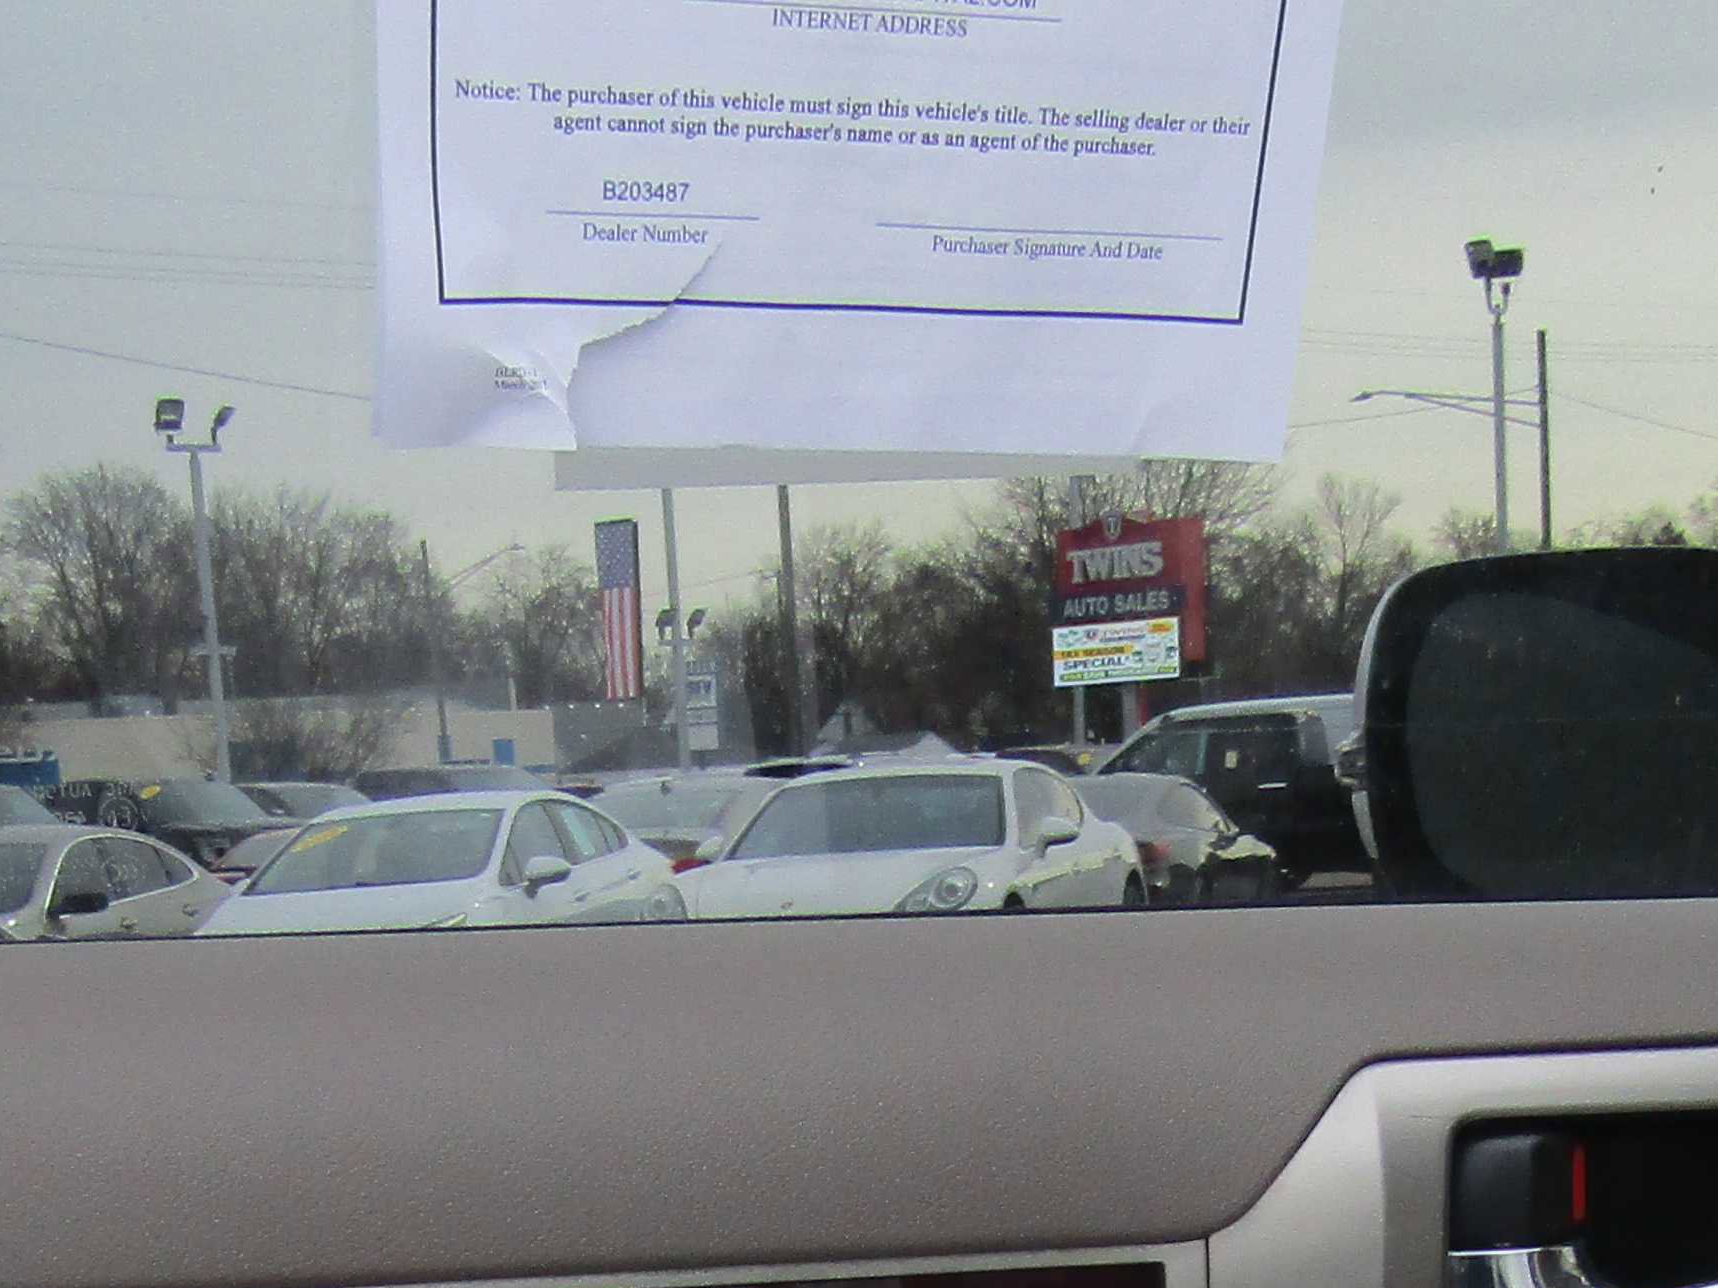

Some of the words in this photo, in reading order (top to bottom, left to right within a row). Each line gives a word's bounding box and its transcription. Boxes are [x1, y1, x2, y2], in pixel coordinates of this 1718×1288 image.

[773, 8, 872, 31] INTERNET
[877, 16, 968, 37] ADDRESS
[455, 79, 520, 101] Notice:
[528, 83, 561, 102] The
[567, 86, 653, 107] purchaser
[659, 89, 680, 106] of
[683, 90, 715, 109] this
[722, 92, 784, 112] vehicle
[790, 98, 832, 115] must
[837, 97, 872, 120] sign
[878, 99, 909, 118] this
[915, 102, 989, 122] vehicle's
[995, 105, 1032, 126] title.
[1039, 107, 1070, 126] The
[1075, 109, 1129, 133] selling
[1135, 111, 1185, 132] dealer
[1190, 119, 1207, 133] or
[1213, 116, 1251, 136] their
[553, 116, 601, 134] agent
[608, 117, 665, 134] cannot
[671, 116, 707, 140] sign
[714, 117, 739, 137] the
[745, 120, 841, 143] purchaser's
[847, 127, 892, 144] name
[898, 131, 916, 145] or
[921, 132, 939, 146] as
[945, 134, 965, 147] an
[970, 133, 1016, 153] agent
[1021, 133, 1044, 151] of
[1044, 134, 1068, 152] the
[1073, 136, 1156, 157] purchaser.
[602, 180, 690, 202] B203487
[583, 222, 637, 243] Dealer
[643, 224, 708, 245] Number
[933, 234, 1009, 255] Purchaser
[1014, 239, 1086, 261] Signature
[1089, 241, 1122, 258] And
[1127, 242, 1163, 260] Date
[1066, 541, 1164, 584] TWINS
[1064, 596, 1108, 618] AUTO
[1114, 589, 1170, 613] SALES
